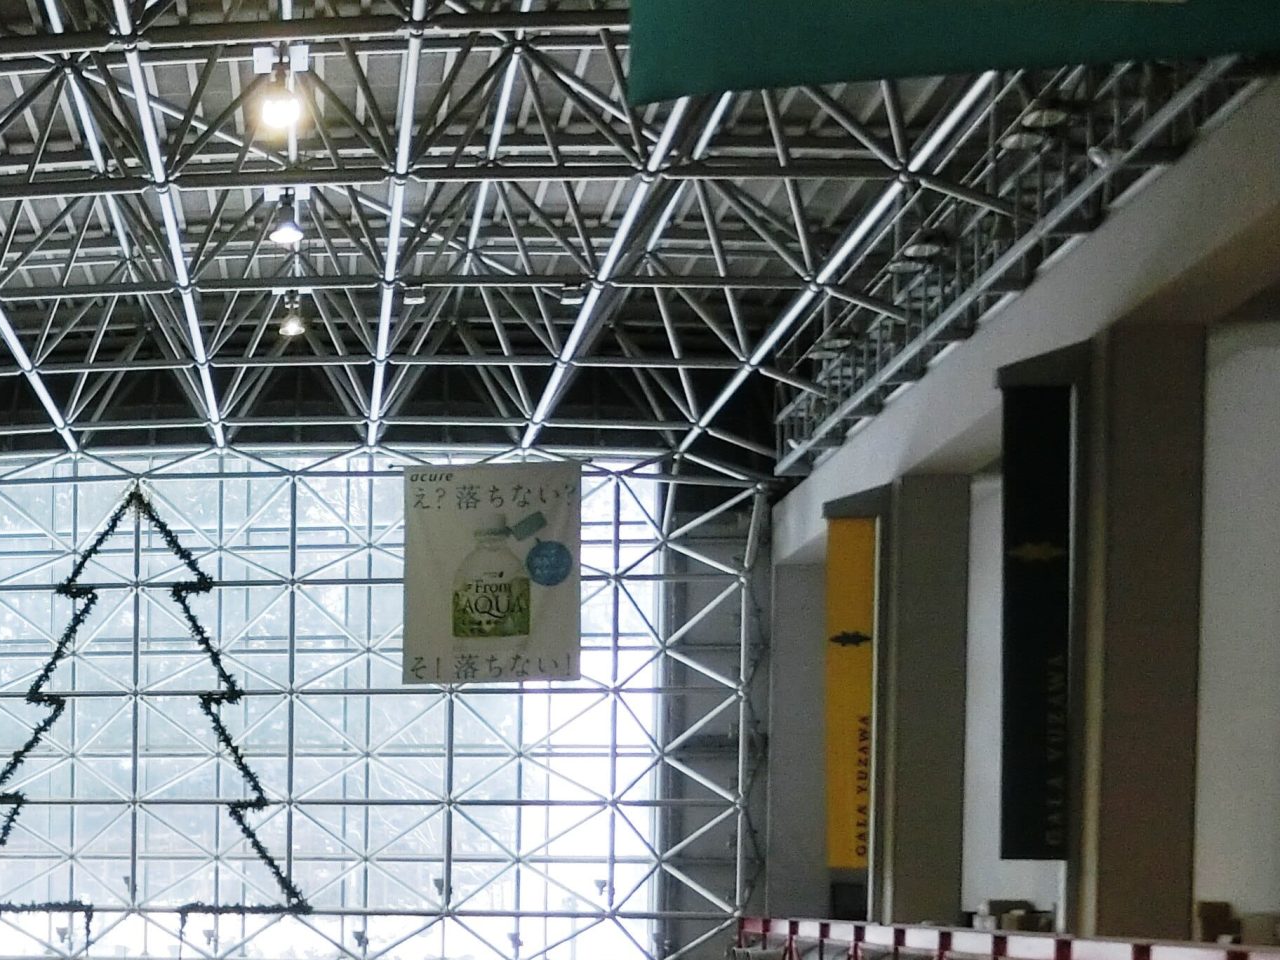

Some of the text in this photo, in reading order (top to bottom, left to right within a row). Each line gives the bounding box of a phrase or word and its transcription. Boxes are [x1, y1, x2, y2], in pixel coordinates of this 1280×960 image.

[410, 471, 454, 482] acure
[475, 580, 512, 593] From
[463, 595, 524, 619] AQUA
[855, 715, 869, 858] GALA YUZAWA
